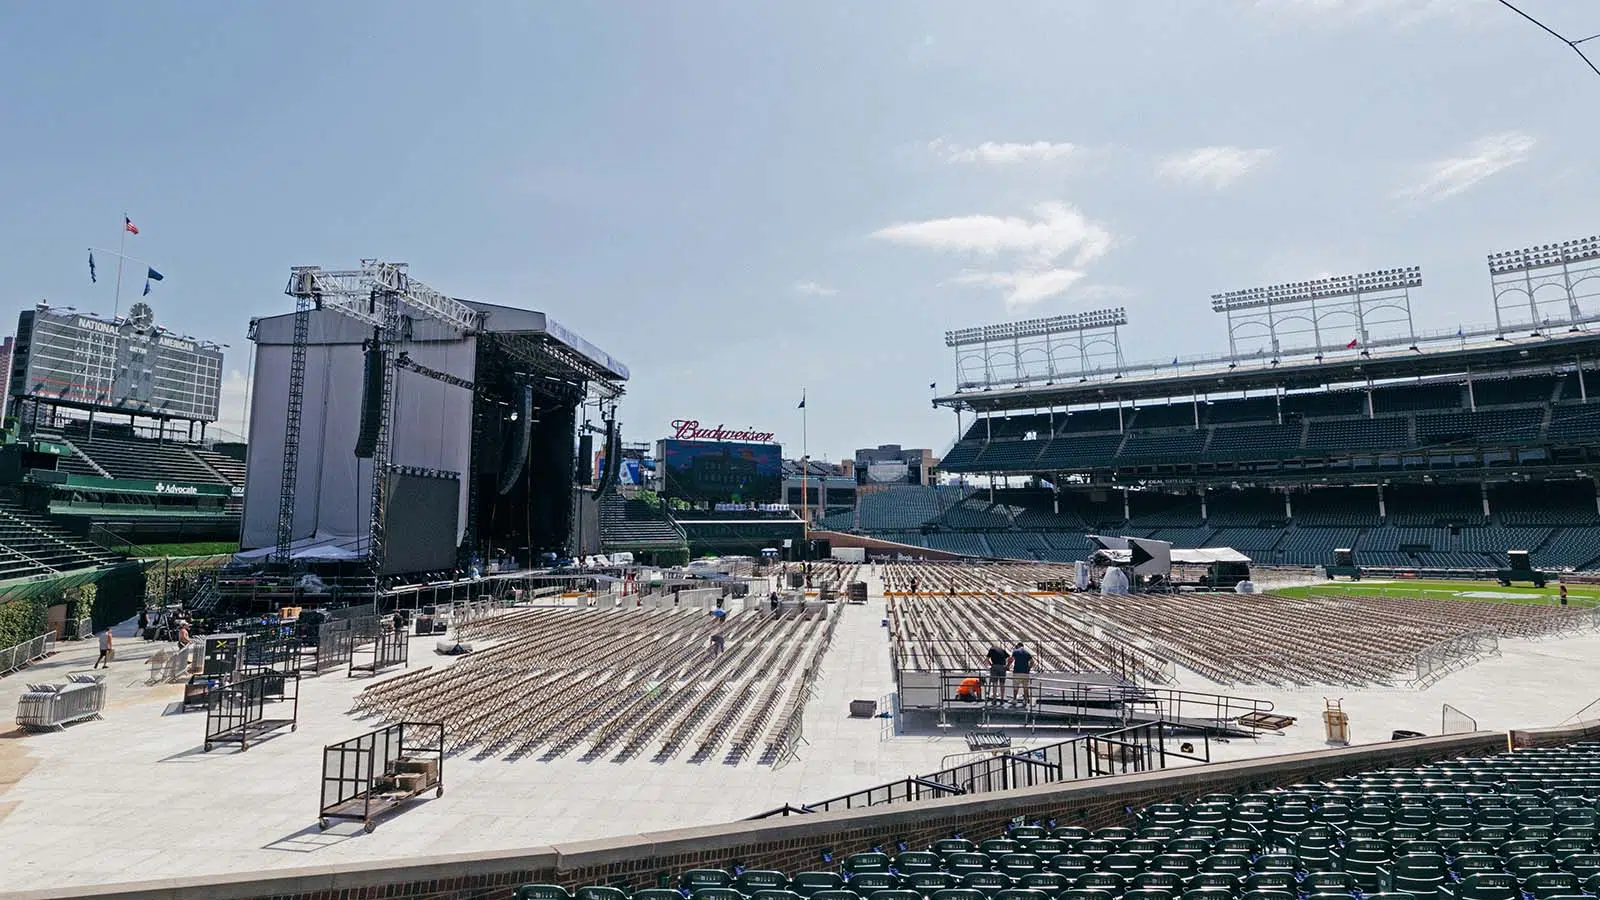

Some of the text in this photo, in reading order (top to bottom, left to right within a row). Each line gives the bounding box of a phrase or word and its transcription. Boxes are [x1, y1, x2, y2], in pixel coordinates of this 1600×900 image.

[78, 317, 120, 336] NATIONAL
[158, 336, 194, 352] AMERICAN
[671, 419, 774, 441] Budweiser
[164, 484, 198, 495] Advocate
